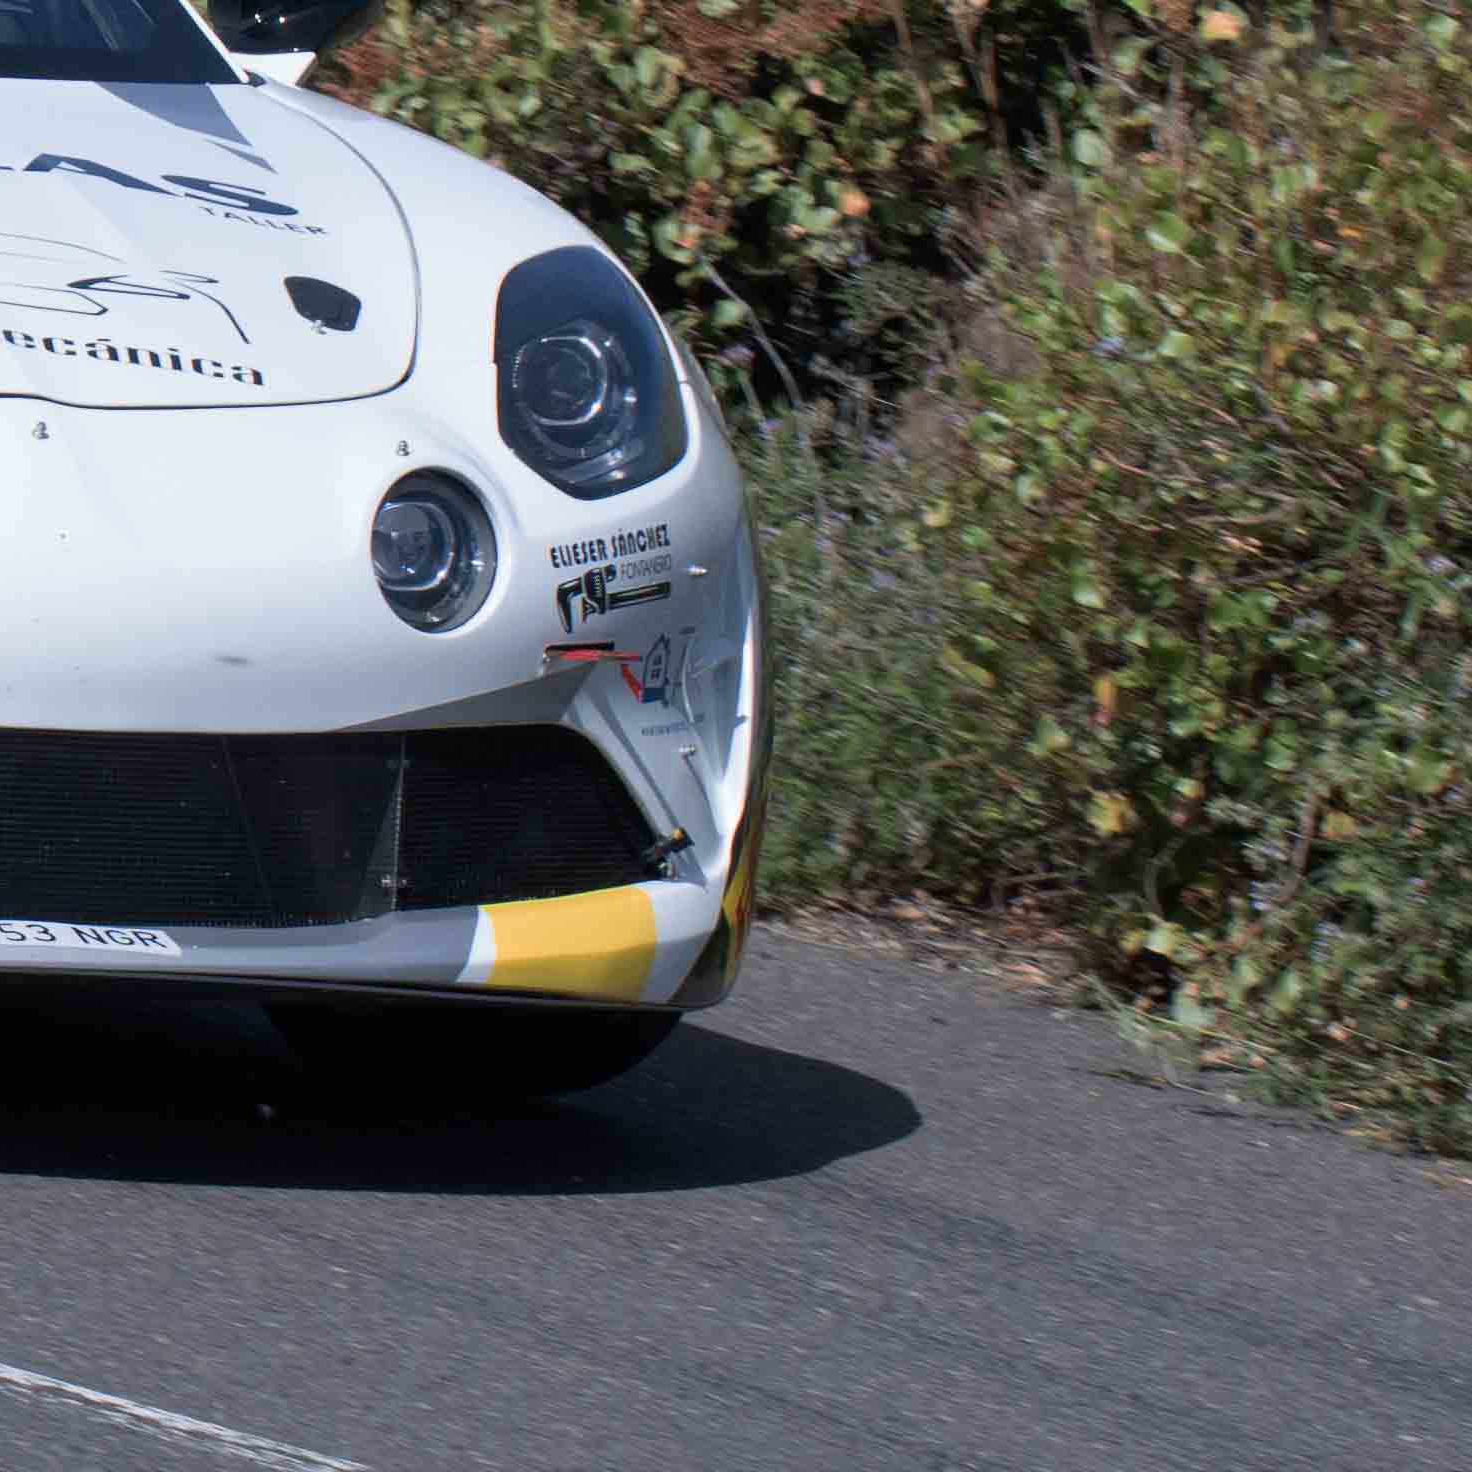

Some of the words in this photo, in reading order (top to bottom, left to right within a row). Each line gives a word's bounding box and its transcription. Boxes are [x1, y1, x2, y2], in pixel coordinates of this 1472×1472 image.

[198, 205, 329, 235] TALLER
[550, 538, 607, 569] ELIESER
[611, 523, 671, 558] SÁNCHEZ
[70, 925, 168, 949] NGR
